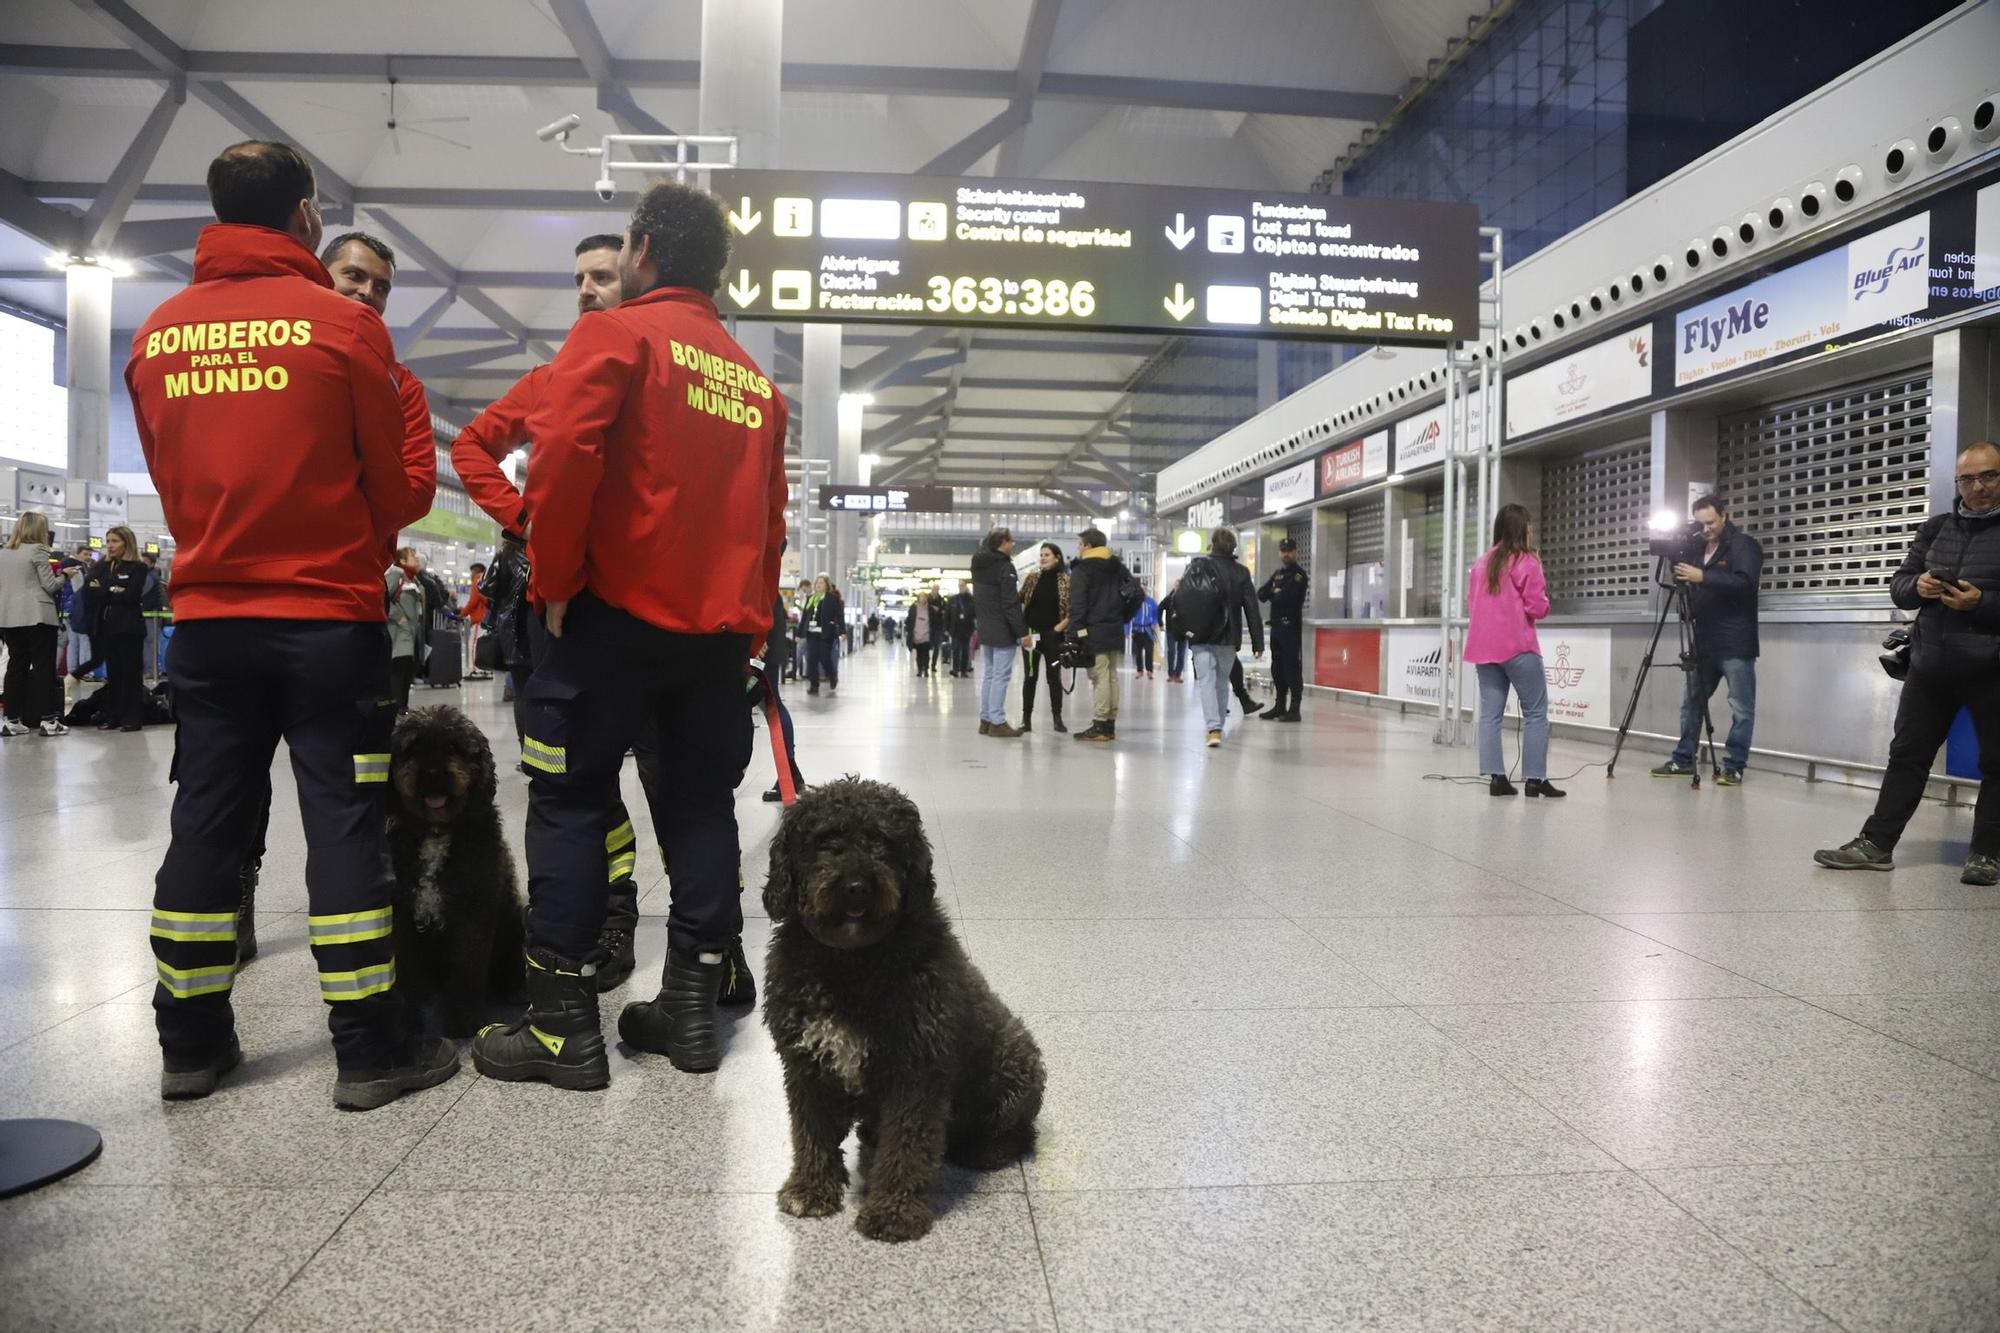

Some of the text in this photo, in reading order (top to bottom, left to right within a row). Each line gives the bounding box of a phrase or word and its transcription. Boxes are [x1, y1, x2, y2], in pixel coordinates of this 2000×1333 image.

[956, 205, 1060, 225] Security control
[1252, 202, 1327, 220] Fundsachen
[956, 223, 1132, 248] Control de seguridad
[1252, 219, 1351, 239] Lost and found
[1253, 236, 1420, 262] Objetos encontrados
[819, 255, 900, 275] Abfertigung
[1853, 253, 1925, 290] Blue Air
[819, 273, 877, 291] Check-in
[818, 291, 923, 311] Facturación
[926, 275, 1096, 317] 363 to 386
[1269, 290, 1366, 309] Digital Tax Free
[1004, 299, 1017, 314] a
[1268, 306, 1454, 333] Sellado Digital Tax Free
[1683, 299, 1769, 354] FlyMe
[1819, 320, 1841, 337] Vols
[145, 319, 312, 359] BOMBEROS
[191, 351, 258, 367] PARA EL
[669, 339, 773, 399] BOMBEROS
[164, 365, 289, 399] MUNDO
[703, 377, 744, 401] PARA EL
[687, 382, 763, 429] MUNDO
[1335, 445, 1361, 466] TURKISH
[1335, 461, 1361, 481] AIRLINES
[89, 537, 103, 548] 326
